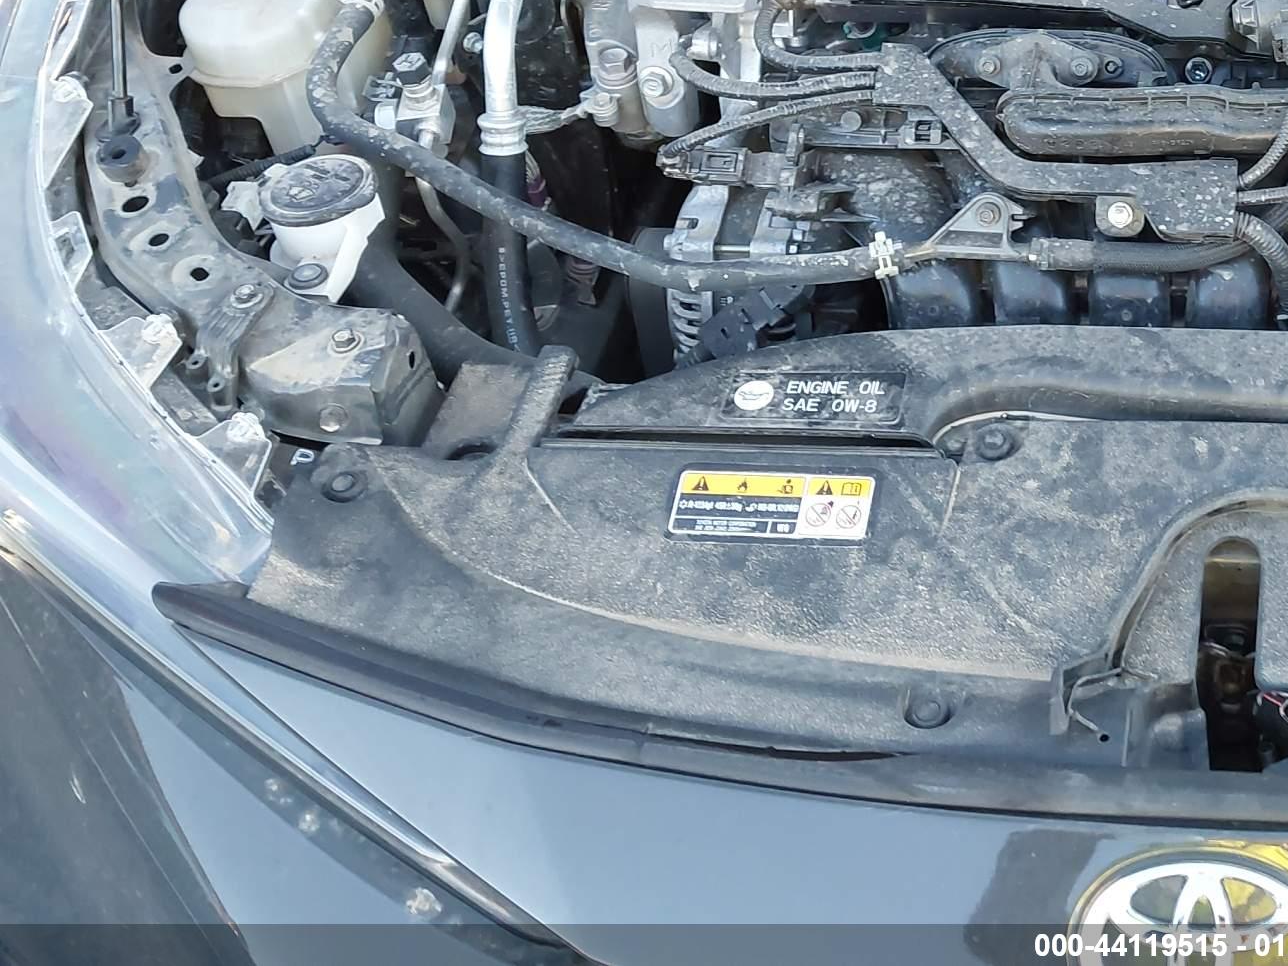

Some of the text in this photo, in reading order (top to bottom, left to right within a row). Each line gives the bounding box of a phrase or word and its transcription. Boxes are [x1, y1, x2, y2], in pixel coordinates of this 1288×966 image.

[785, 380, 885, 395] ENGINE OIL
[782, 398, 820, 412] SAE
